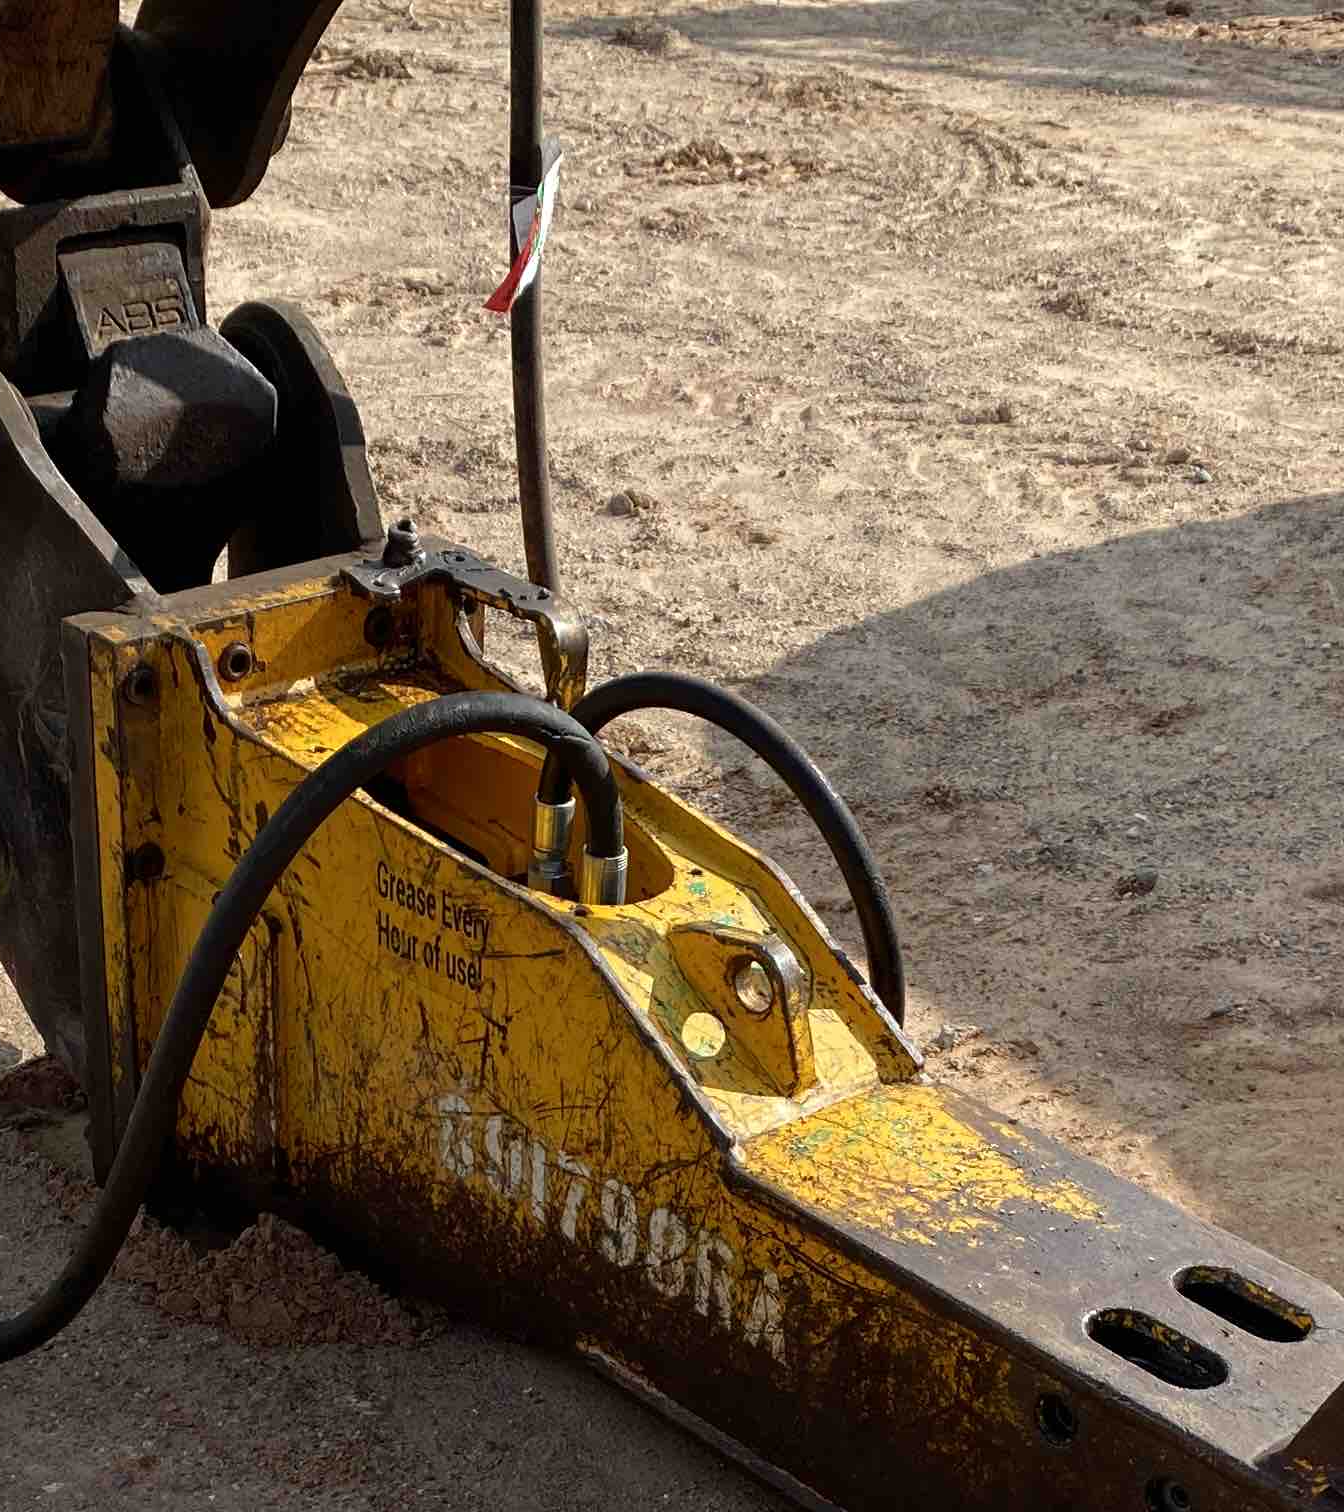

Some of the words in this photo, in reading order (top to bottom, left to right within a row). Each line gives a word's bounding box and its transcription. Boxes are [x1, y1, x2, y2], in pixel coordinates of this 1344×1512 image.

[377, 861, 436, 920] Grease
[442, 889, 489, 954] Every
[377, 909, 417, 960] Hour
[423, 935, 441, 972] of
